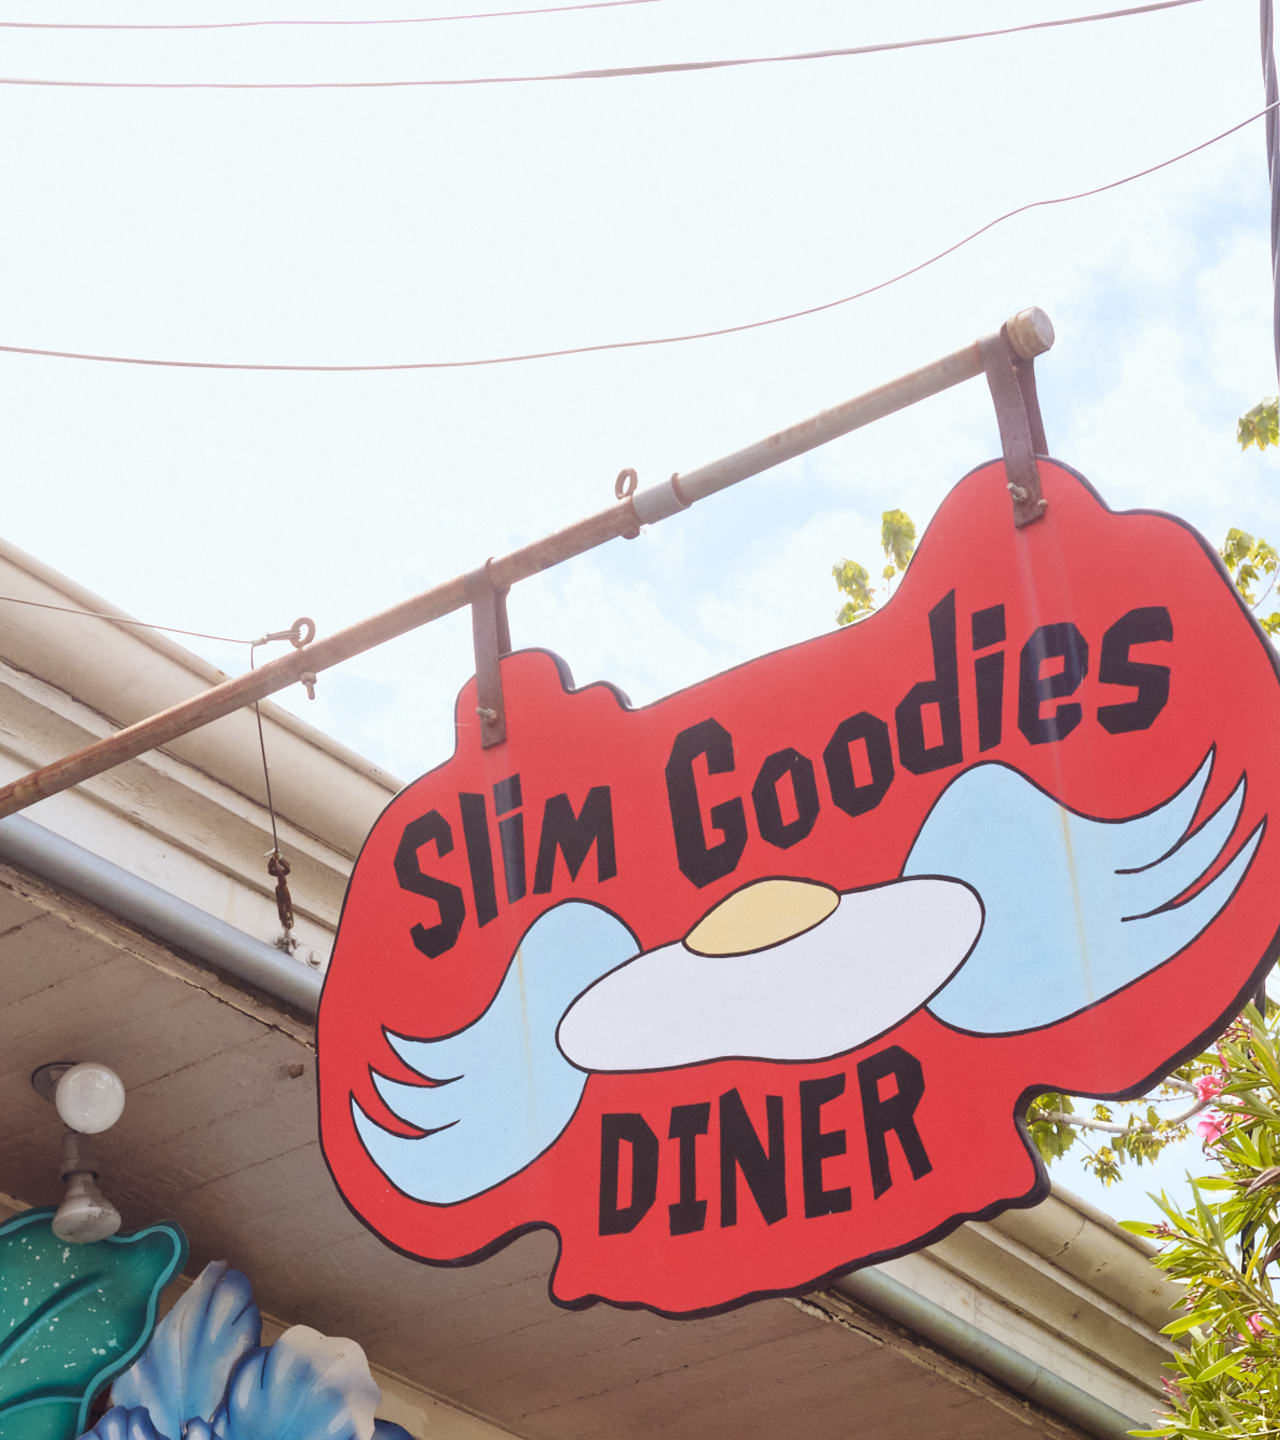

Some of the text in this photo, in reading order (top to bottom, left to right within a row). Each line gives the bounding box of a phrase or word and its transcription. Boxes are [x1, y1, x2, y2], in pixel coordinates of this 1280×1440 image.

[392, 588, 1174, 960] Slim Goodies
[597, 1043, 934, 1239] DINER
